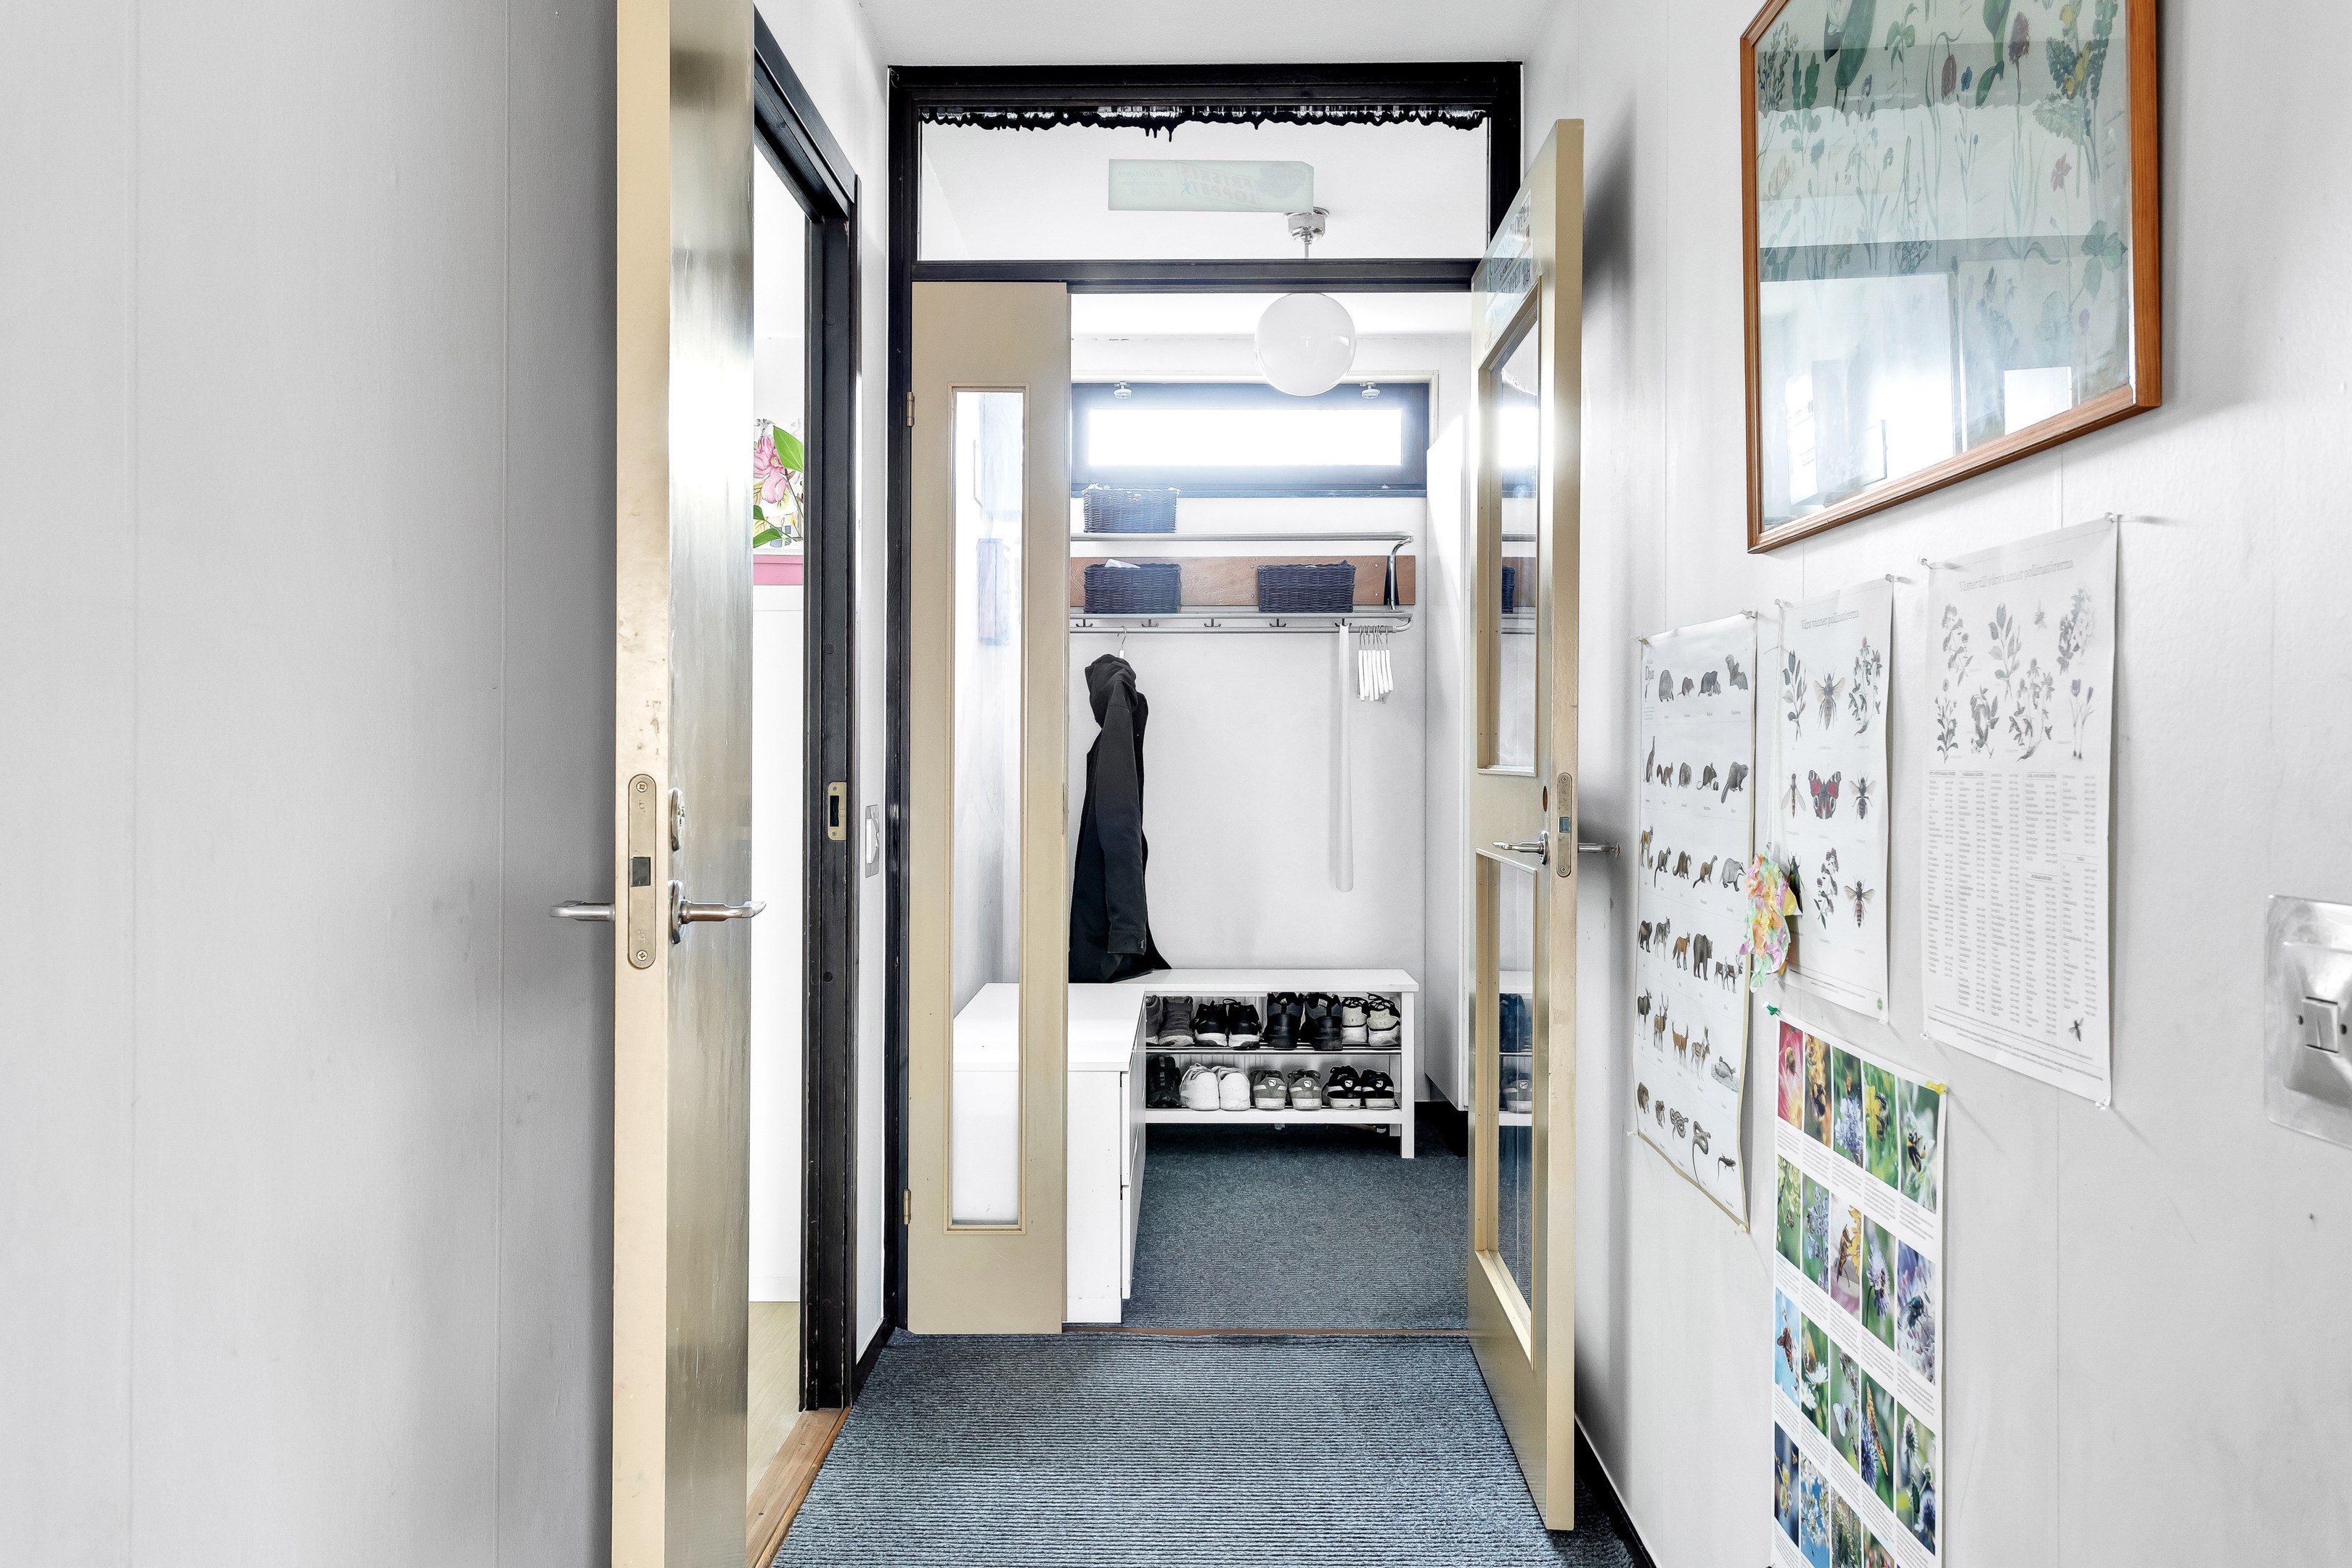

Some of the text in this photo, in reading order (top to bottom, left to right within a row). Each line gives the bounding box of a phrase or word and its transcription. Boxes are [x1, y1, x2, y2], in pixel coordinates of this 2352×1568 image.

[1959, 560, 2073, 591] Växter till våra vänner pollinatörerna
[1801, 610, 1859, 629] Våra vänner pollinatörerna
